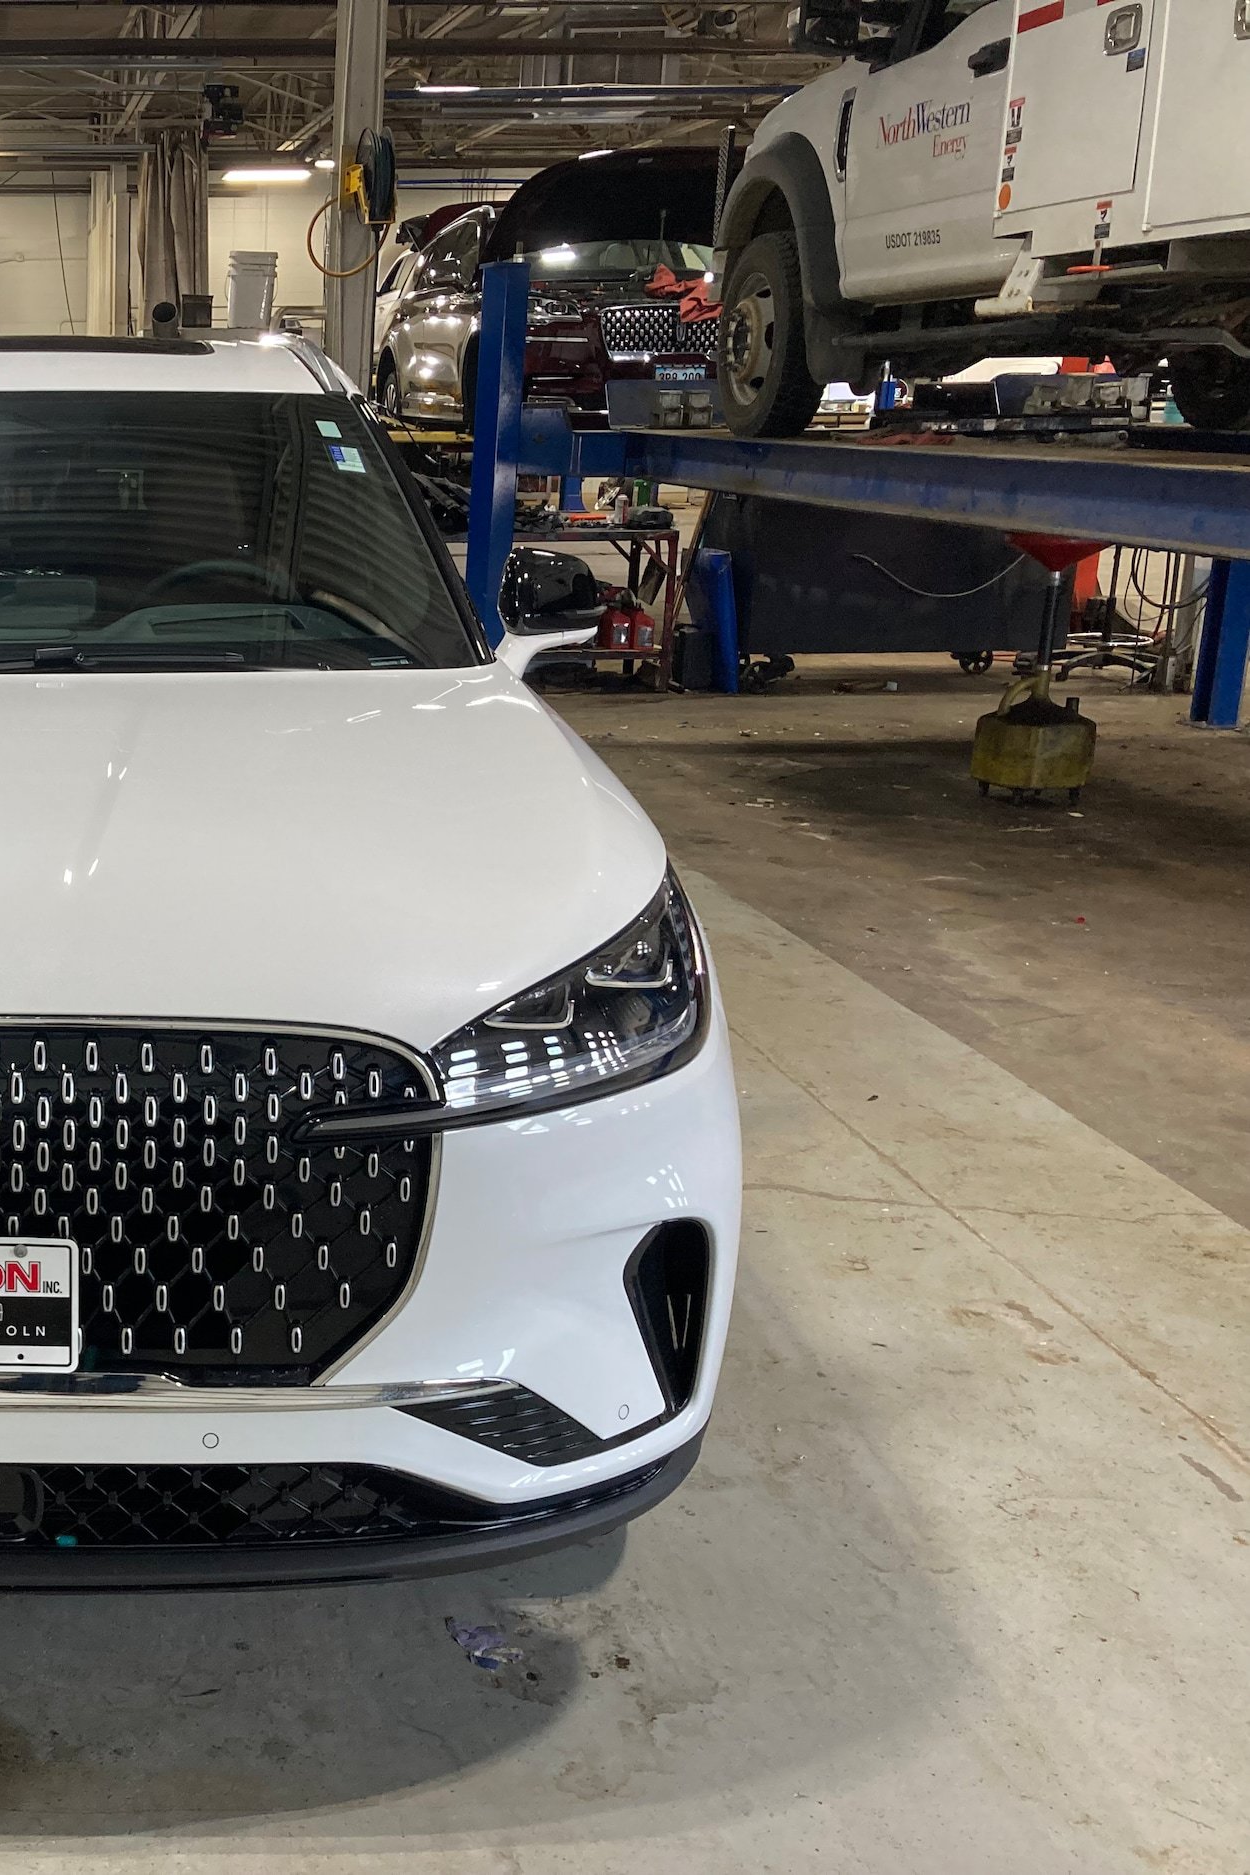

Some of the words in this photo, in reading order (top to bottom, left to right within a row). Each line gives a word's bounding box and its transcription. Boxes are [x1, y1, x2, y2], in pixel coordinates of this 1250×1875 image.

[875, 98, 971, 149] NorthWestern
[932, 134, 969, 160] Energy
[885, 232, 911, 249] USDOT
[914, 229, 941, 246] 219835
[42, 1280, 63, 1294] INC.
